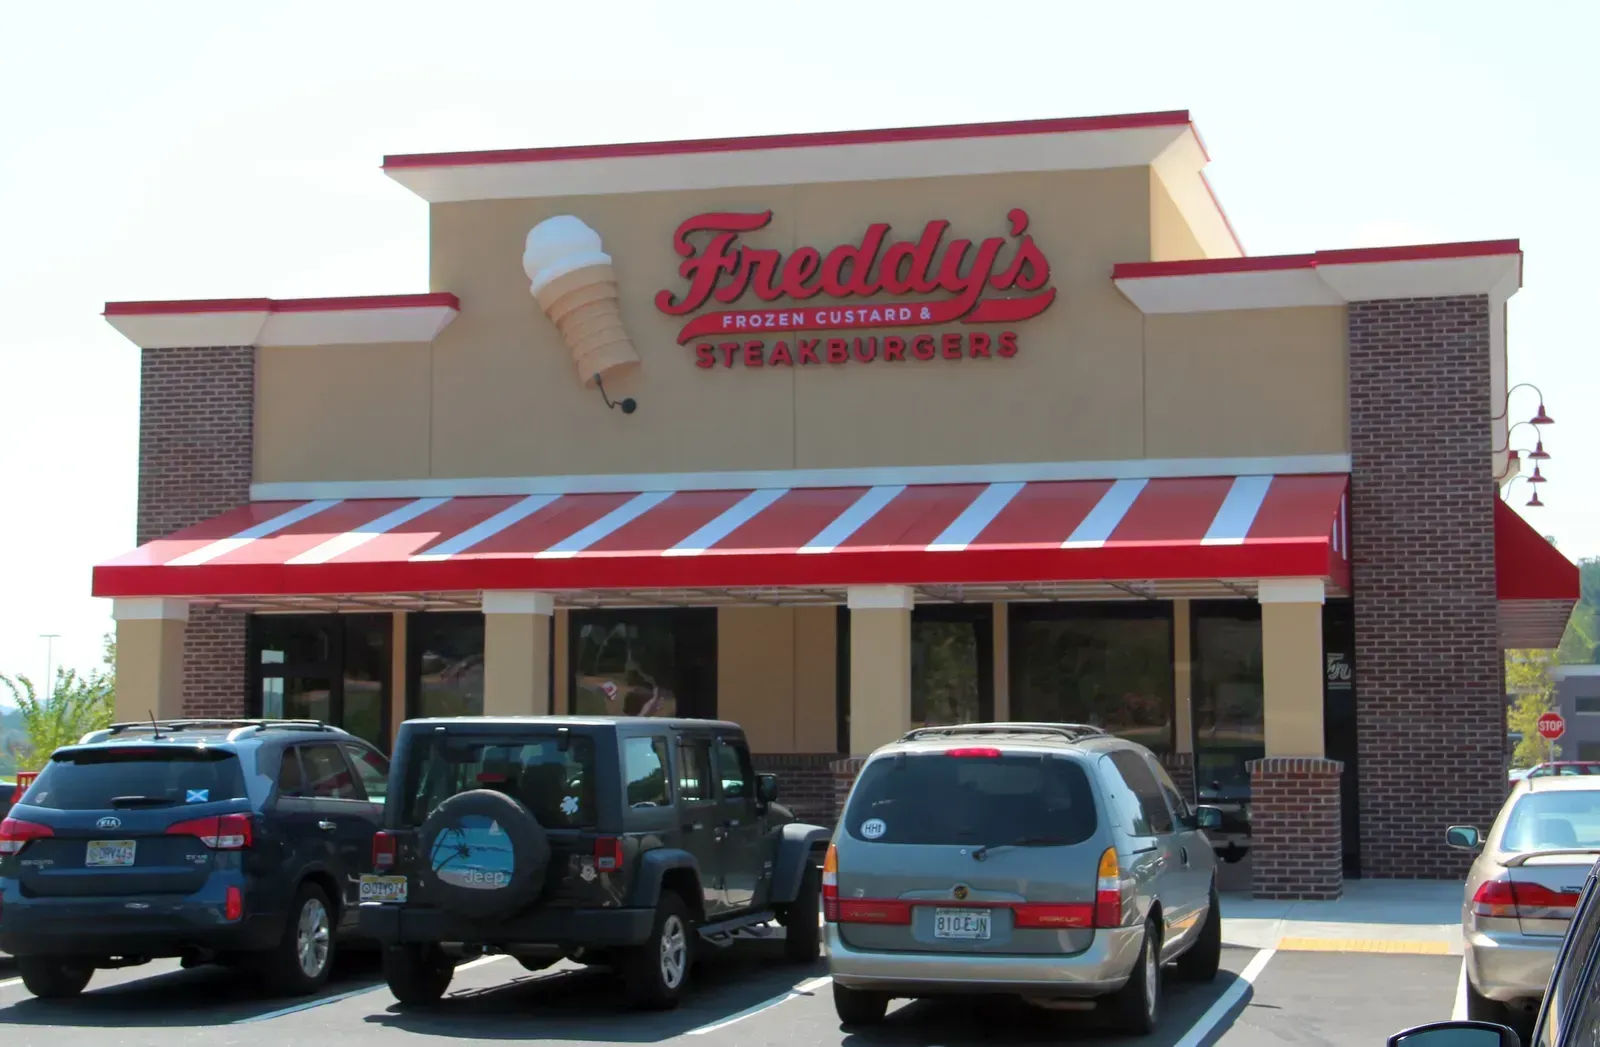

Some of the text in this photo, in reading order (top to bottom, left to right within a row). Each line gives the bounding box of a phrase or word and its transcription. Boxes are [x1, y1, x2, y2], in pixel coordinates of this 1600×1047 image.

[655, 208, 1052, 324] Freddy's
[722, 306, 932, 329] FROZEN CUSTARD &
[695, 330, 1018, 369] STEAKBURGERS
[1539, 720, 1562, 731] STOP
[100, 819, 117, 828] KIA
[464, 868, 504, 887] Jeep
